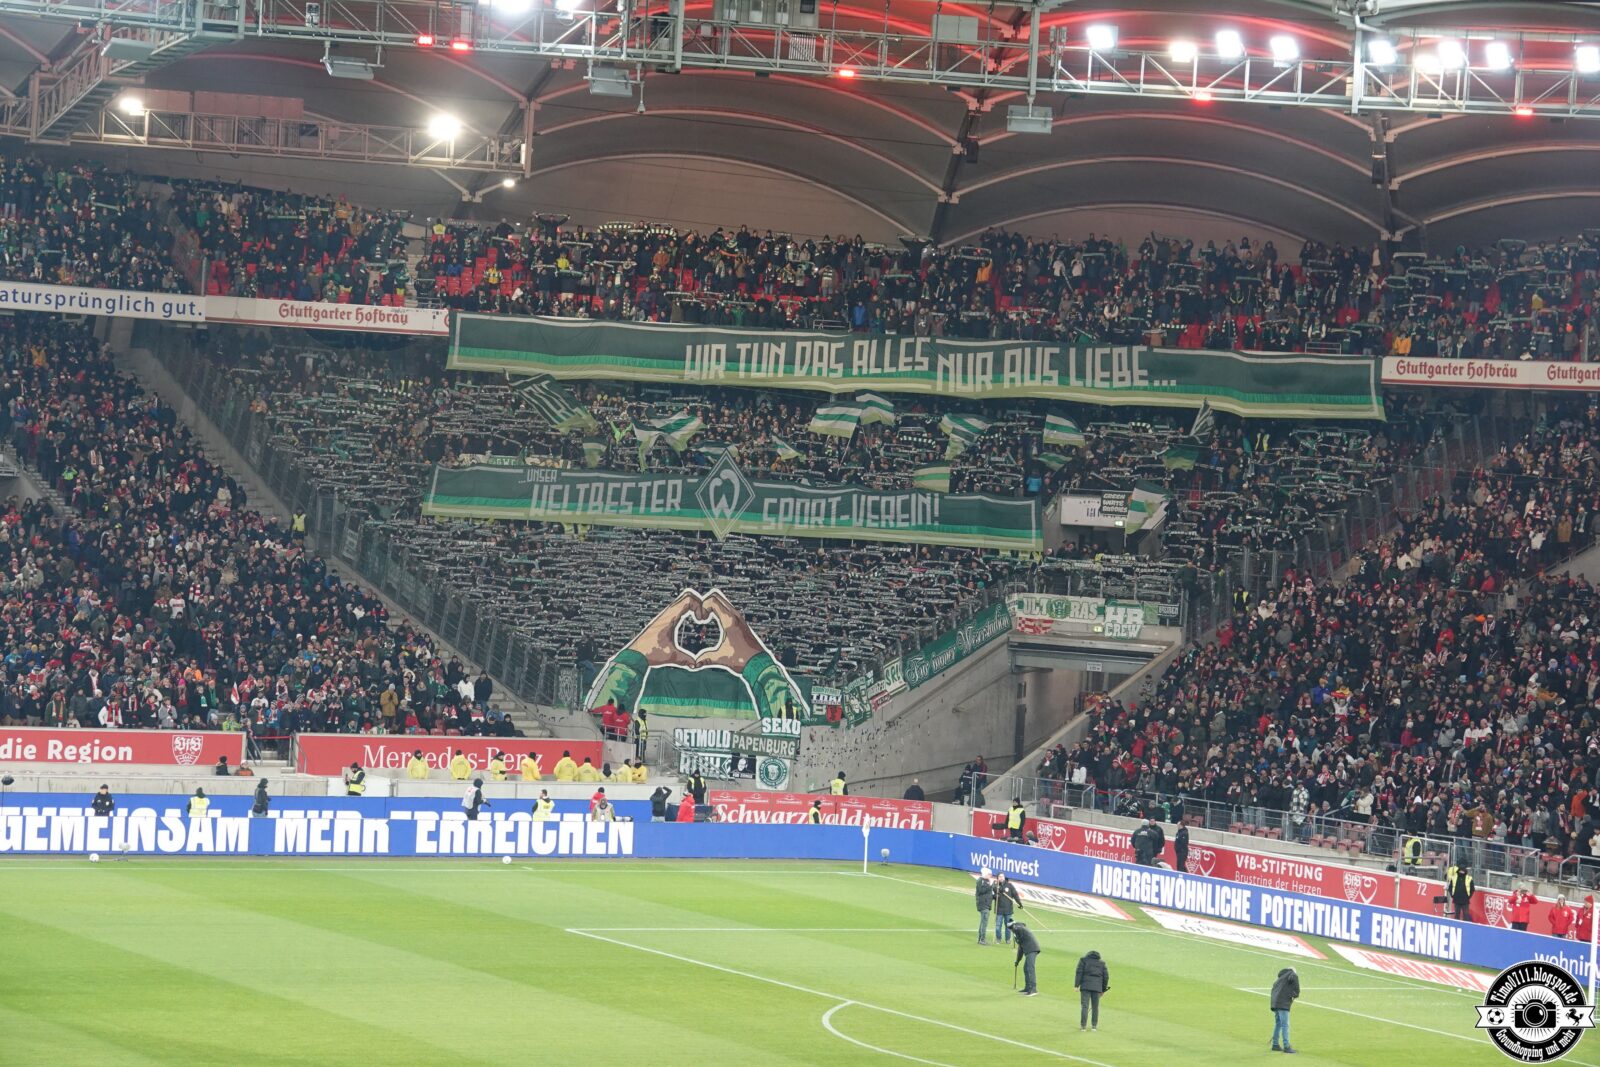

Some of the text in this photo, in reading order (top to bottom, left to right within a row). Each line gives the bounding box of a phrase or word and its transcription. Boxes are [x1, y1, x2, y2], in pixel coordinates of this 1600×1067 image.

[0, 288, 202, 317] atursprünglich gut.
[279, 303, 352, 322] Stuttgarter
[684, 336, 1177, 393] WIR TUN DAS ALLES NUR AUS LIEBE...
[1396, 359, 1518, 379] Stuttgarter Hofbräu
[529, 479, 683, 517] WELTBESTER
[762, 492, 940, 530] SPORT-VEREIN!
[1105, 606, 1145, 625] HB
[1104, 623, 1141, 638] CREW
[674, 728, 731, 748] DETMOLD
[761, 717, 801, 735] SEKO
[0, 737, 133, 764] die Region
[732, 734, 796, 755] PAPENBURG
[0, 807, 634, 855] GEMEINSAM MEHR ERREICHEN
[988, 813, 997, 825] 71
[970, 850, 1040, 877] wohninvest
[1235, 854, 1323, 881] VfB-STIFTUNG
[1235, 870, 1322, 896] Brustring der Herzen
[1416, 882, 1427, 896] 72
[1261, 893, 1361, 943] POTENTIALE
[1371, 912, 1463, 961] ERKENNEN
